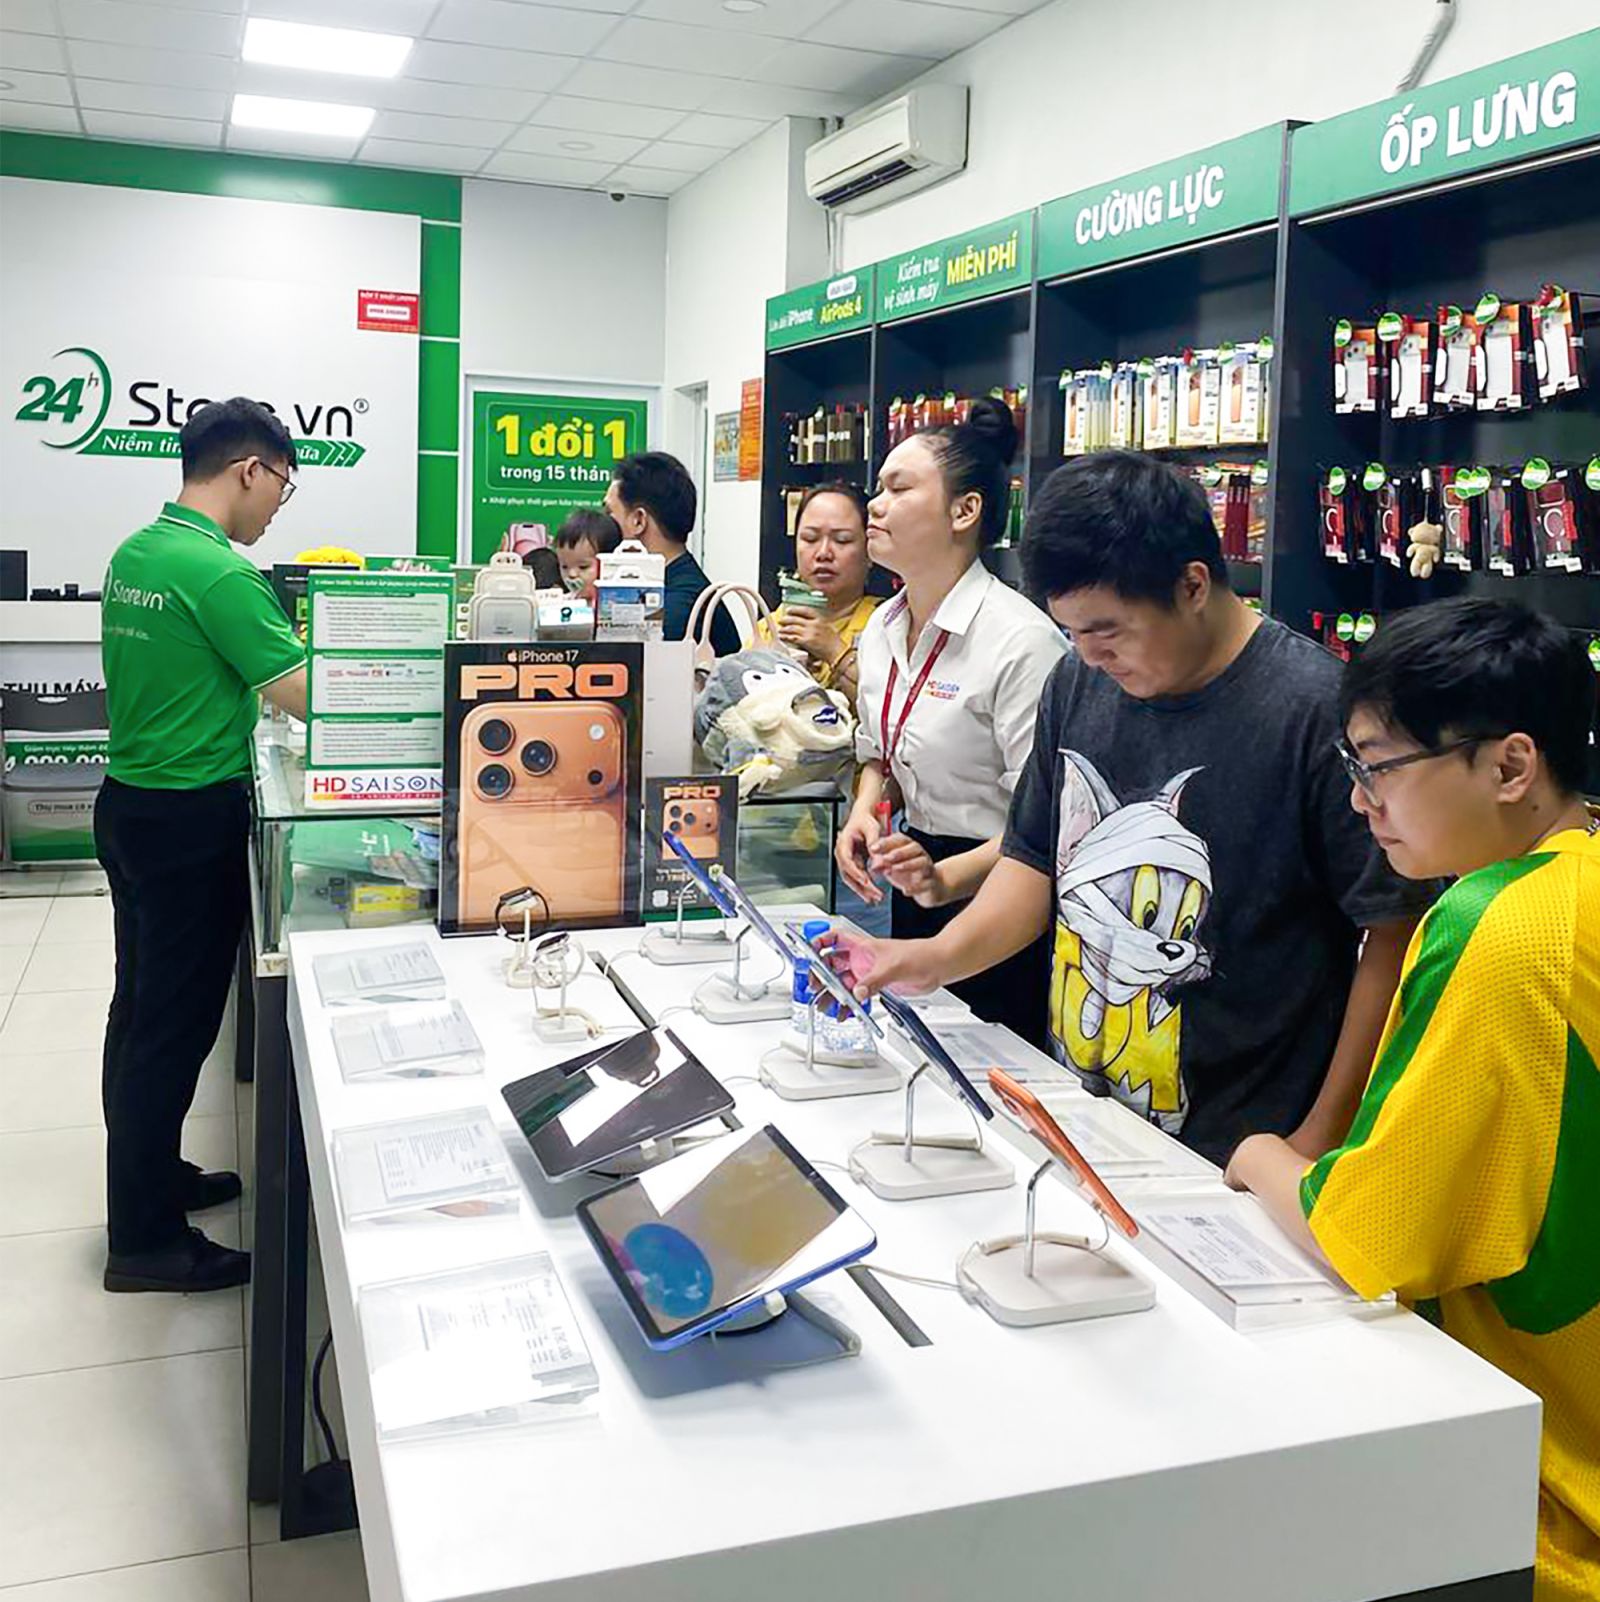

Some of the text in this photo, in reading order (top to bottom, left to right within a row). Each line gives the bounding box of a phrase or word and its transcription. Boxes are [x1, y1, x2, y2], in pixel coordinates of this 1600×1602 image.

[1380, 71, 1577, 174] ỐP LƯNG
[1076, 165, 1224, 245] CƯỜNG LỰC
[946, 232, 1018, 286] MIỄN PHÍ
[129, 381, 354, 437] St.vn
[102, 432, 154, 452] Niềm
[496, 414, 626, 460] 1 đổi 1
[501, 465, 611, 482] trong 15 thán
[518, 650, 579, 663] iPhone 17
[460, 664, 628, 700] PRO
[313, 776, 347, 793] HD
[664, 785, 721, 800] PRO
